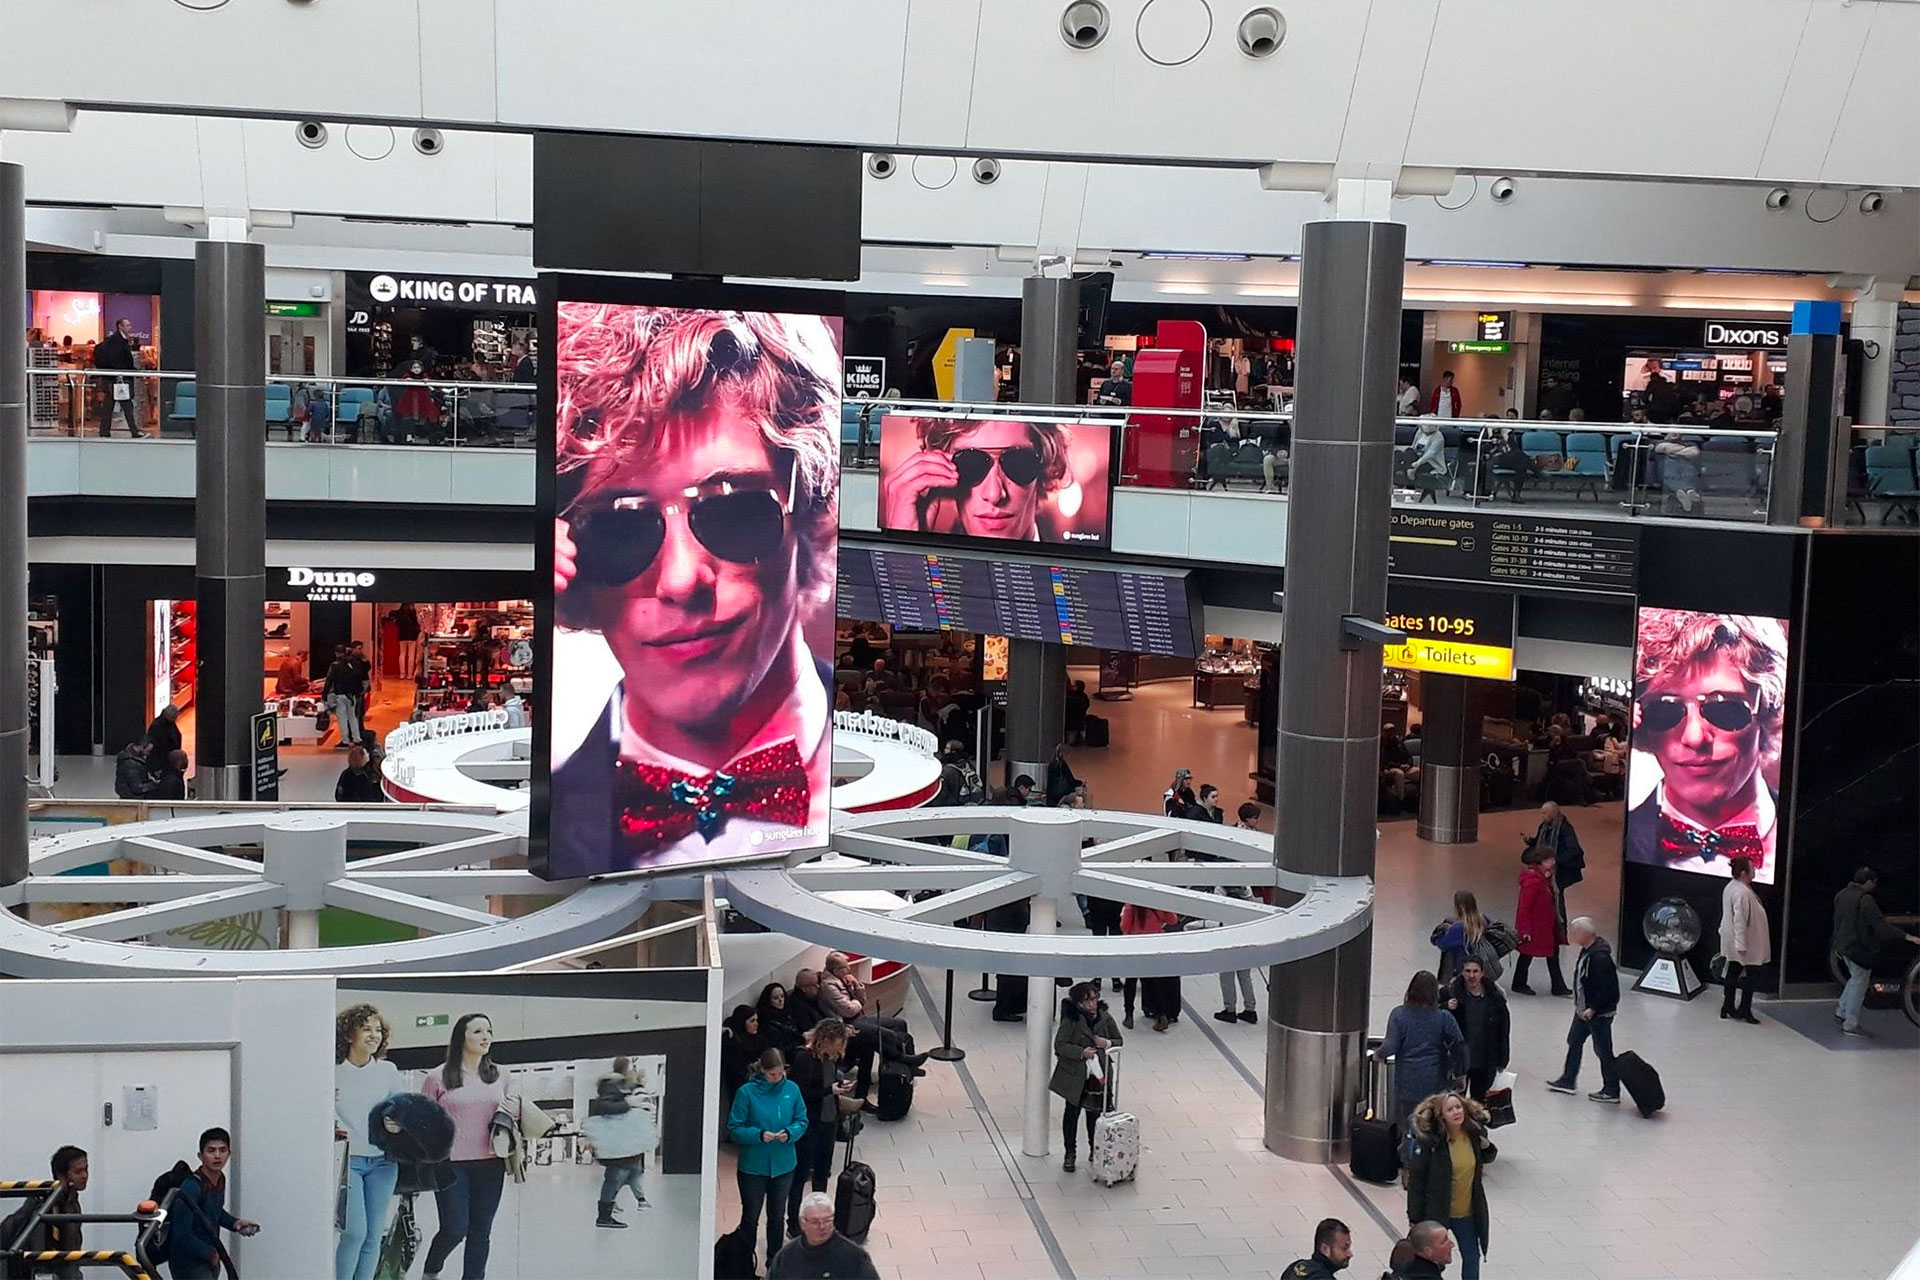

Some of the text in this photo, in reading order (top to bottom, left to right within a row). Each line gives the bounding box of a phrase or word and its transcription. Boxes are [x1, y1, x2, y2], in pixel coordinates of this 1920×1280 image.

[400, 280, 454, 301] KING
[458, 282, 488, 302] OF
[349, 311, 369, 324] JD
[1708, 324, 1779, 345] Dixons
[846, 373, 880, 384] KING
[1400, 514, 1447, 527] Departure
[1449, 518, 1475, 530] gates
[1492, 521, 1510, 530] Gates
[1492, 533, 1510, 541] Gates
[1491, 544, 1509, 552] Gates
[1491, 555, 1508, 563] Gates
[1490, 566, 1508, 574] Gates
[1543, 572, 1565, 580] minutes
[287, 567, 375, 587] Dune
[1429, 616, 1475, 636] 10-95
[1424, 646, 1476, 665] Toilets
[765, 825, 819, 841] sunglass hu
